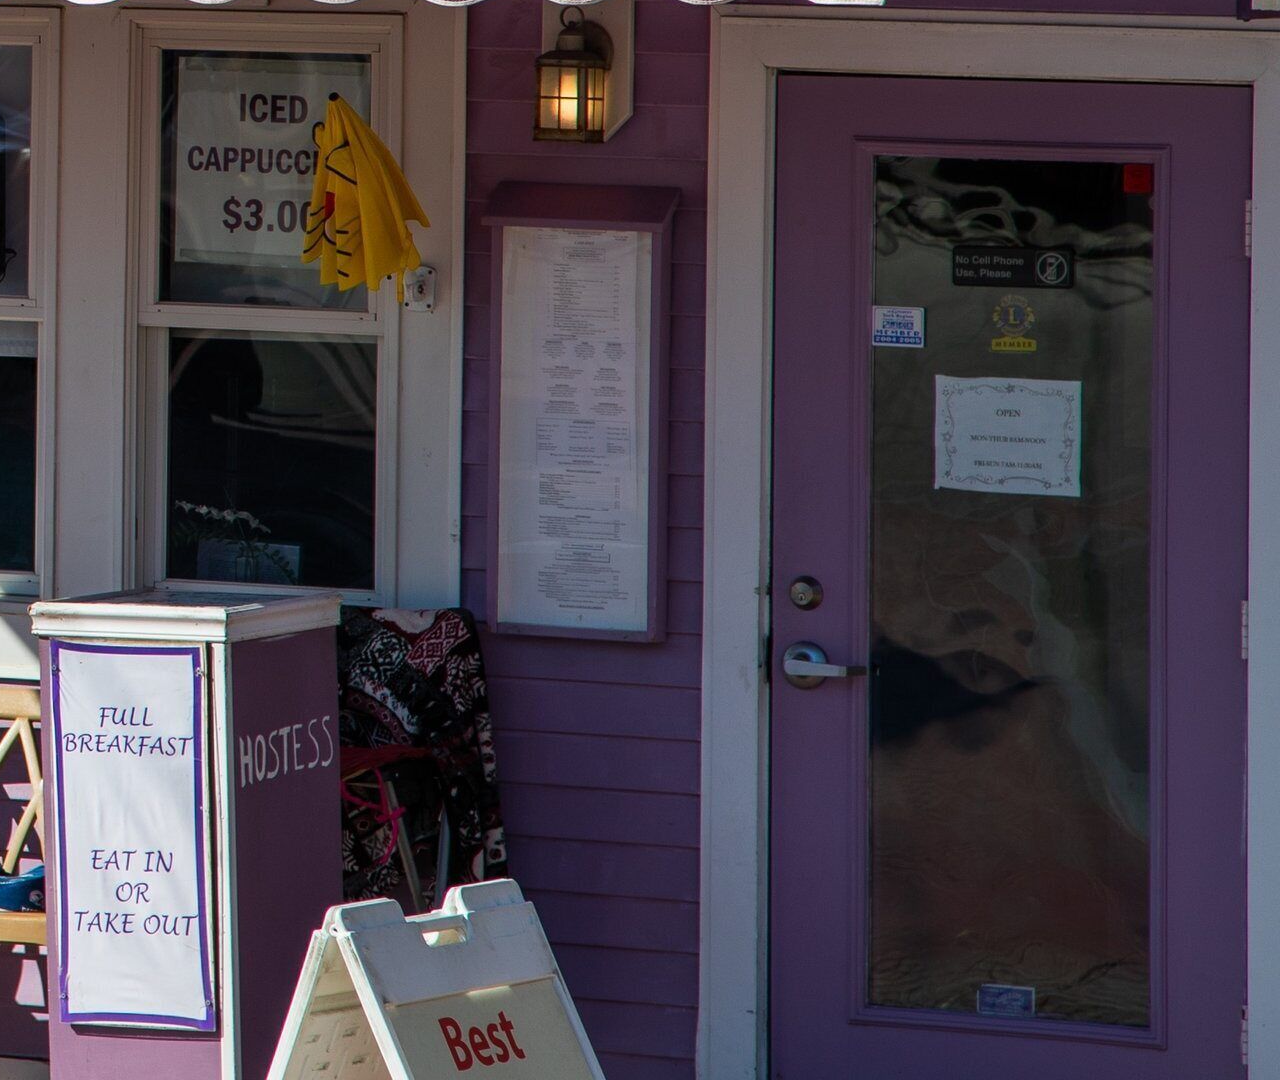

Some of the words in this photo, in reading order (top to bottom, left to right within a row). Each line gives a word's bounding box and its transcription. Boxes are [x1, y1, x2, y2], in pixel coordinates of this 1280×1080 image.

[240, 93, 308, 124] ICED
[187, 145, 319, 176] CAPPUCCI
[955, 255, 970, 265] No
[972, 255, 991, 265] Cell
[993, 256, 1025, 266] Phone
[955, 268, 978, 279] Use,
[979, 268, 1013, 279] Please
[876, 329, 921, 337] MEMBER
[996, 408, 1022, 418] OPEN
[99, 706, 154, 728] FULL
[63, 732, 195, 758] BREAKFAST
[239, 715, 335, 788] HOSTESS
[90, 849, 138, 872] EAT
[143, 850, 174, 873] IN
[115, 882, 151, 904] OR
[73, 910, 135, 936] TAKE
[143, 913, 199, 938] OUT
[436, 1009, 526, 1073] Best
